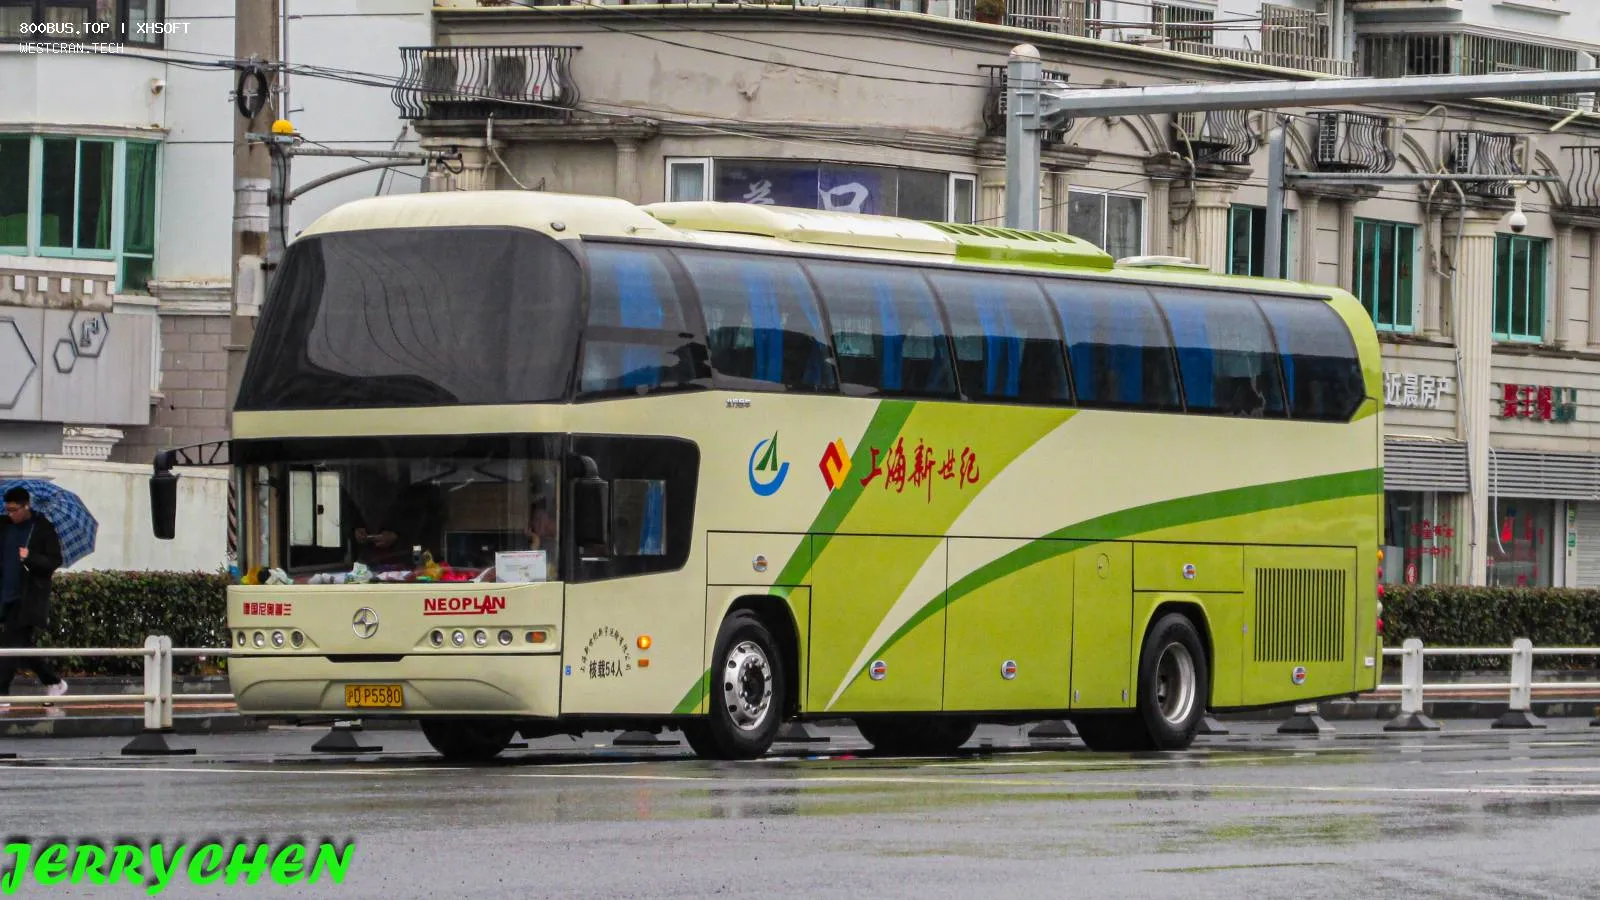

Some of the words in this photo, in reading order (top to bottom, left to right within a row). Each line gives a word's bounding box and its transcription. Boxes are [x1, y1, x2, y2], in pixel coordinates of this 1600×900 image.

[860, 437, 980, 504] 上海新世纪
[424, 595, 506, 615] NEOPLAN
[589, 660, 622, 679] 核载54人
